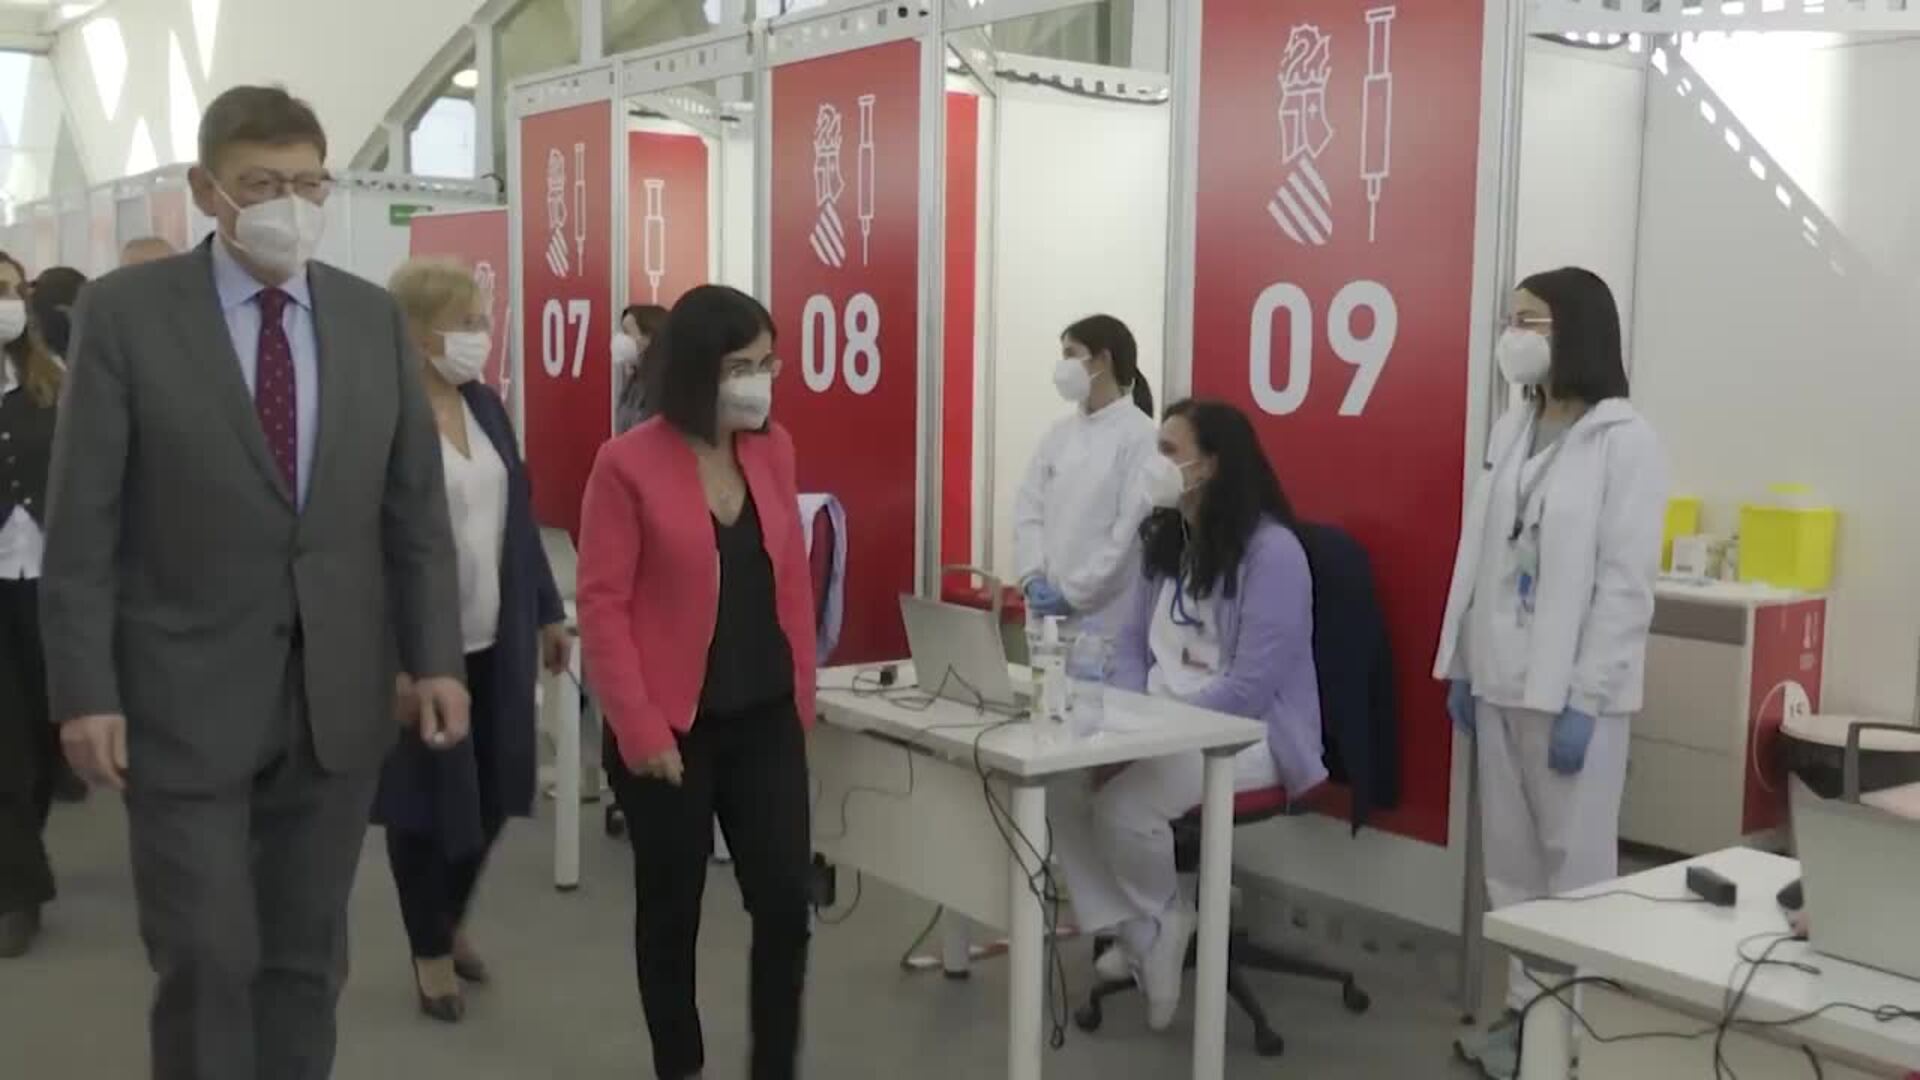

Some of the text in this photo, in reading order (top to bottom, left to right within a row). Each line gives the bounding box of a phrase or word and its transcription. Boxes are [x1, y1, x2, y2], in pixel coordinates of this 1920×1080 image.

[543, 298, 591, 377] 07
[801, 292, 881, 394] 08
[1250, 279, 1398, 416] 09
